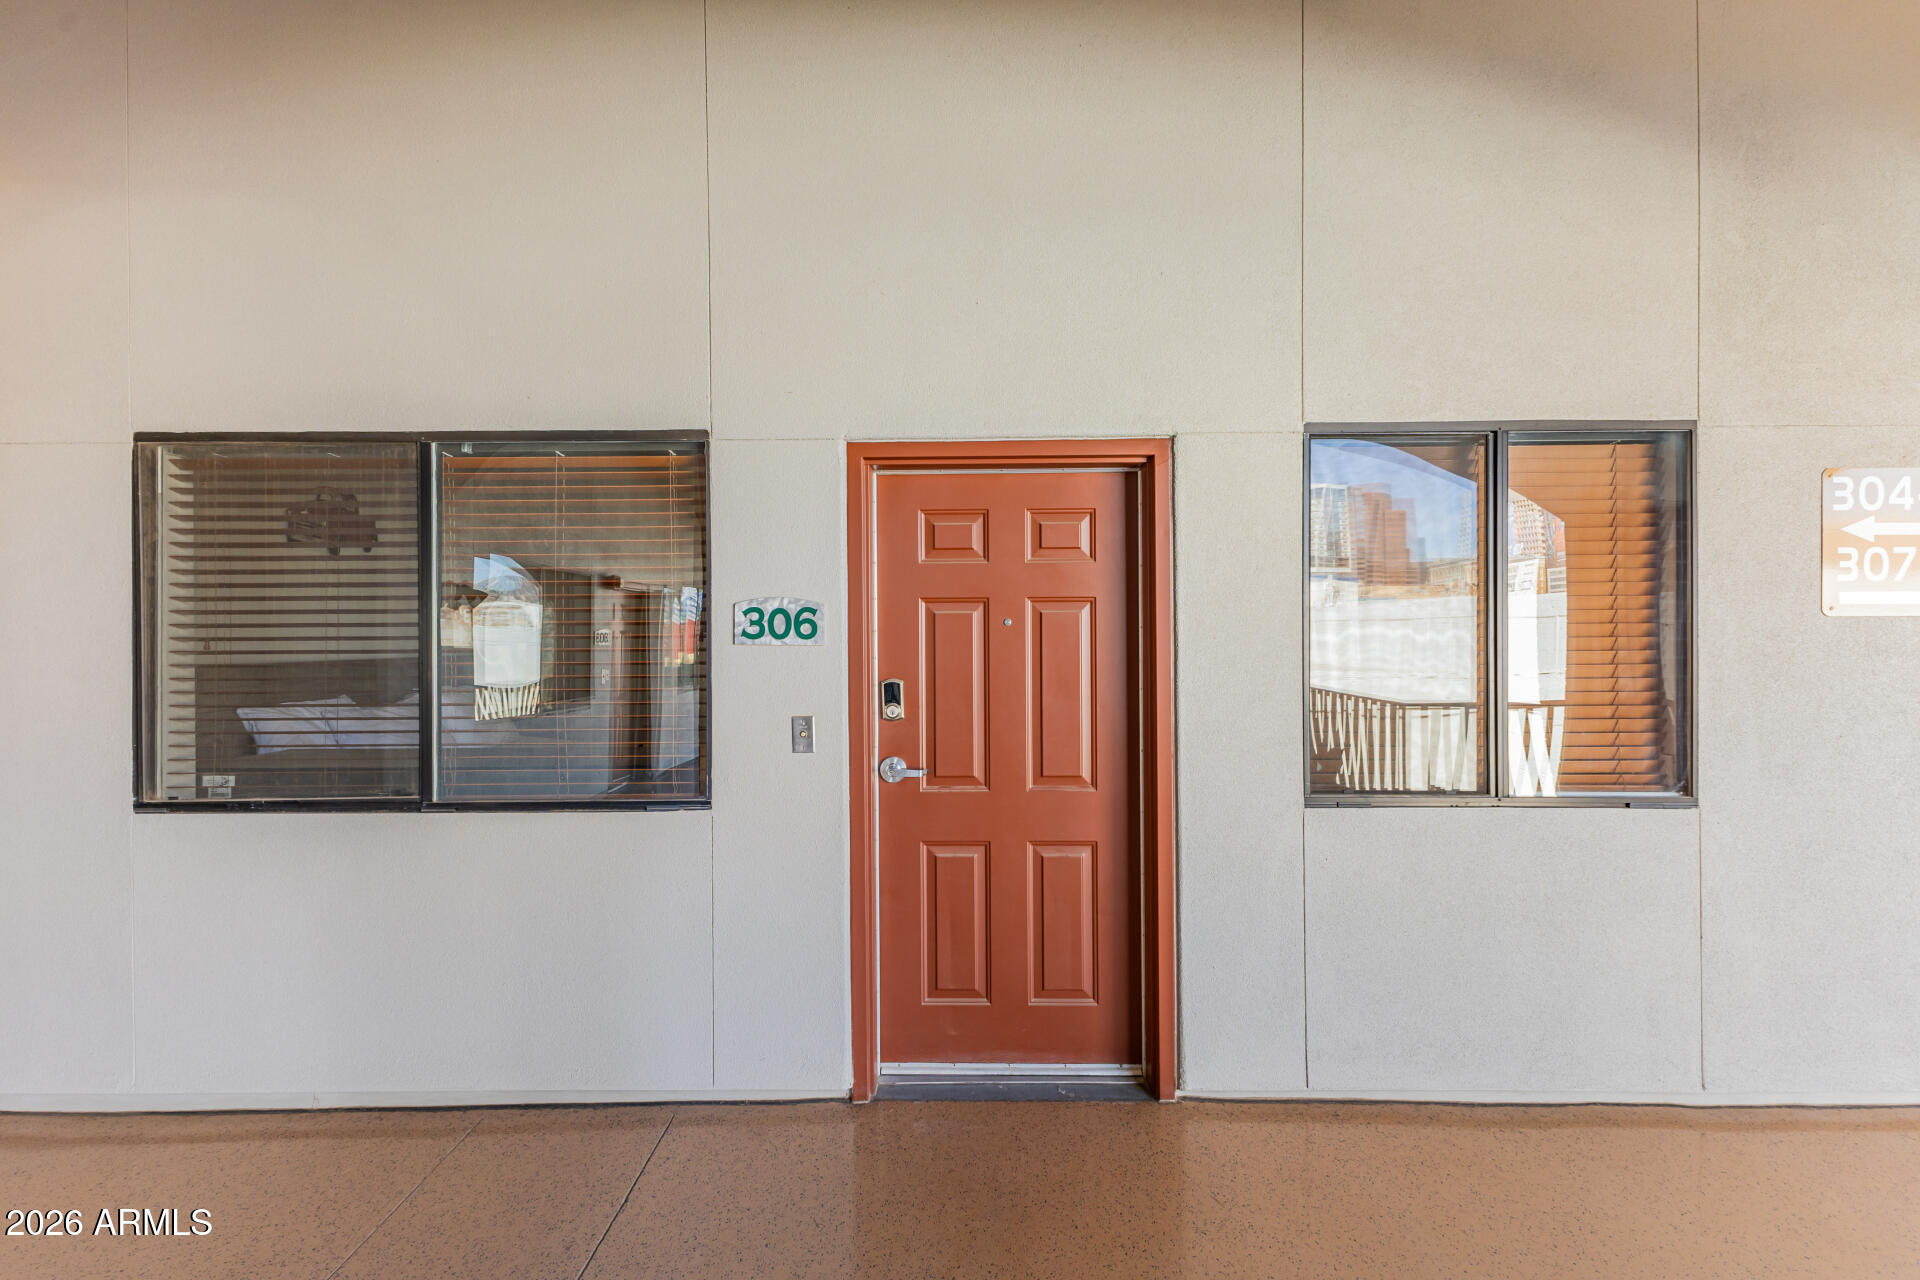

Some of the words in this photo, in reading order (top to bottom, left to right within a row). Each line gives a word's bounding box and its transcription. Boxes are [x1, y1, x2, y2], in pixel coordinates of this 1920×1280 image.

[1832, 475, 1920, 511] 304
[1837, 546, 1917, 583] 307
[740, 606, 818, 640] 306
